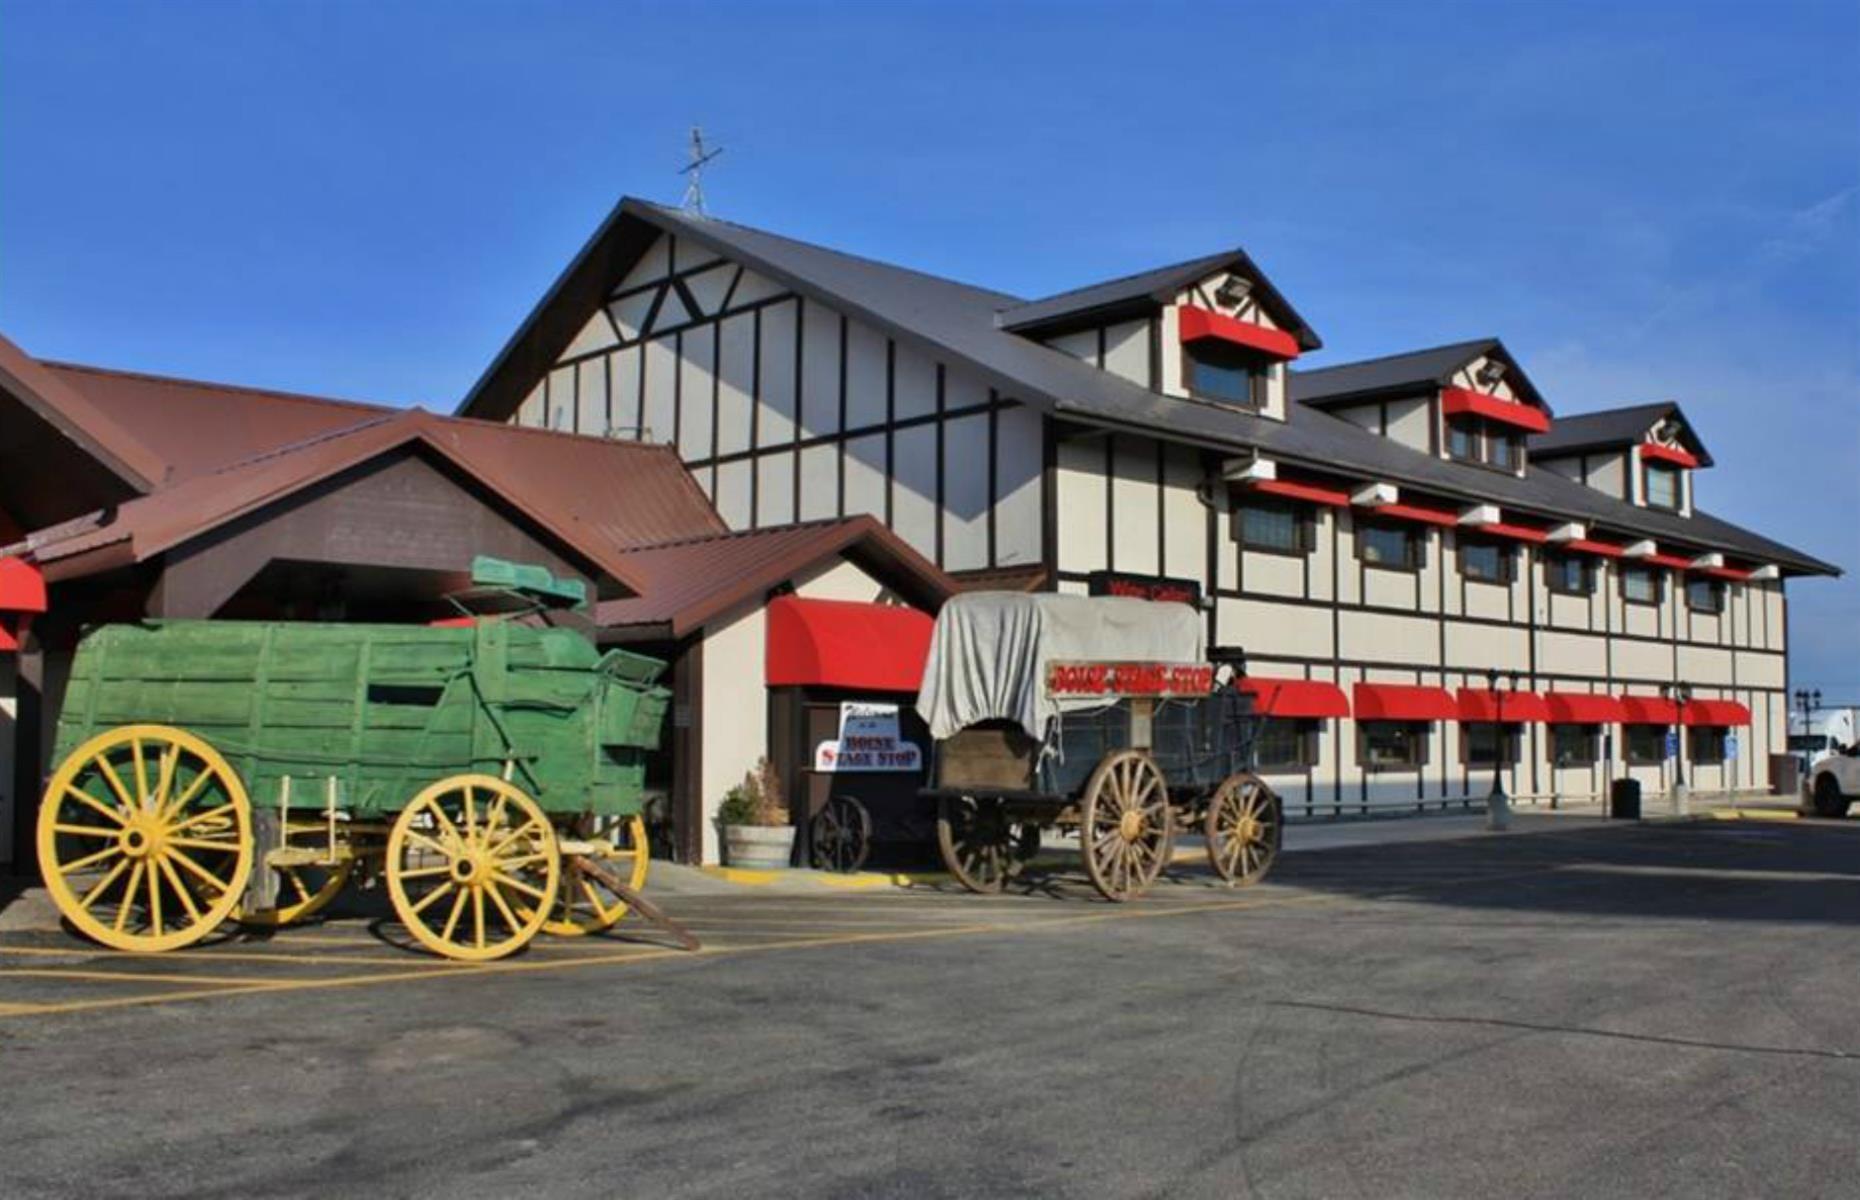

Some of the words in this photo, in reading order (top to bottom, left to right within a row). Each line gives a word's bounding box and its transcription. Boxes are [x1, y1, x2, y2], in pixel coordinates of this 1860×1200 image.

[1172, 665, 1213, 695] STOP
[821, 749, 873, 767] STAGE
[877, 750, 918, 767] STOP
